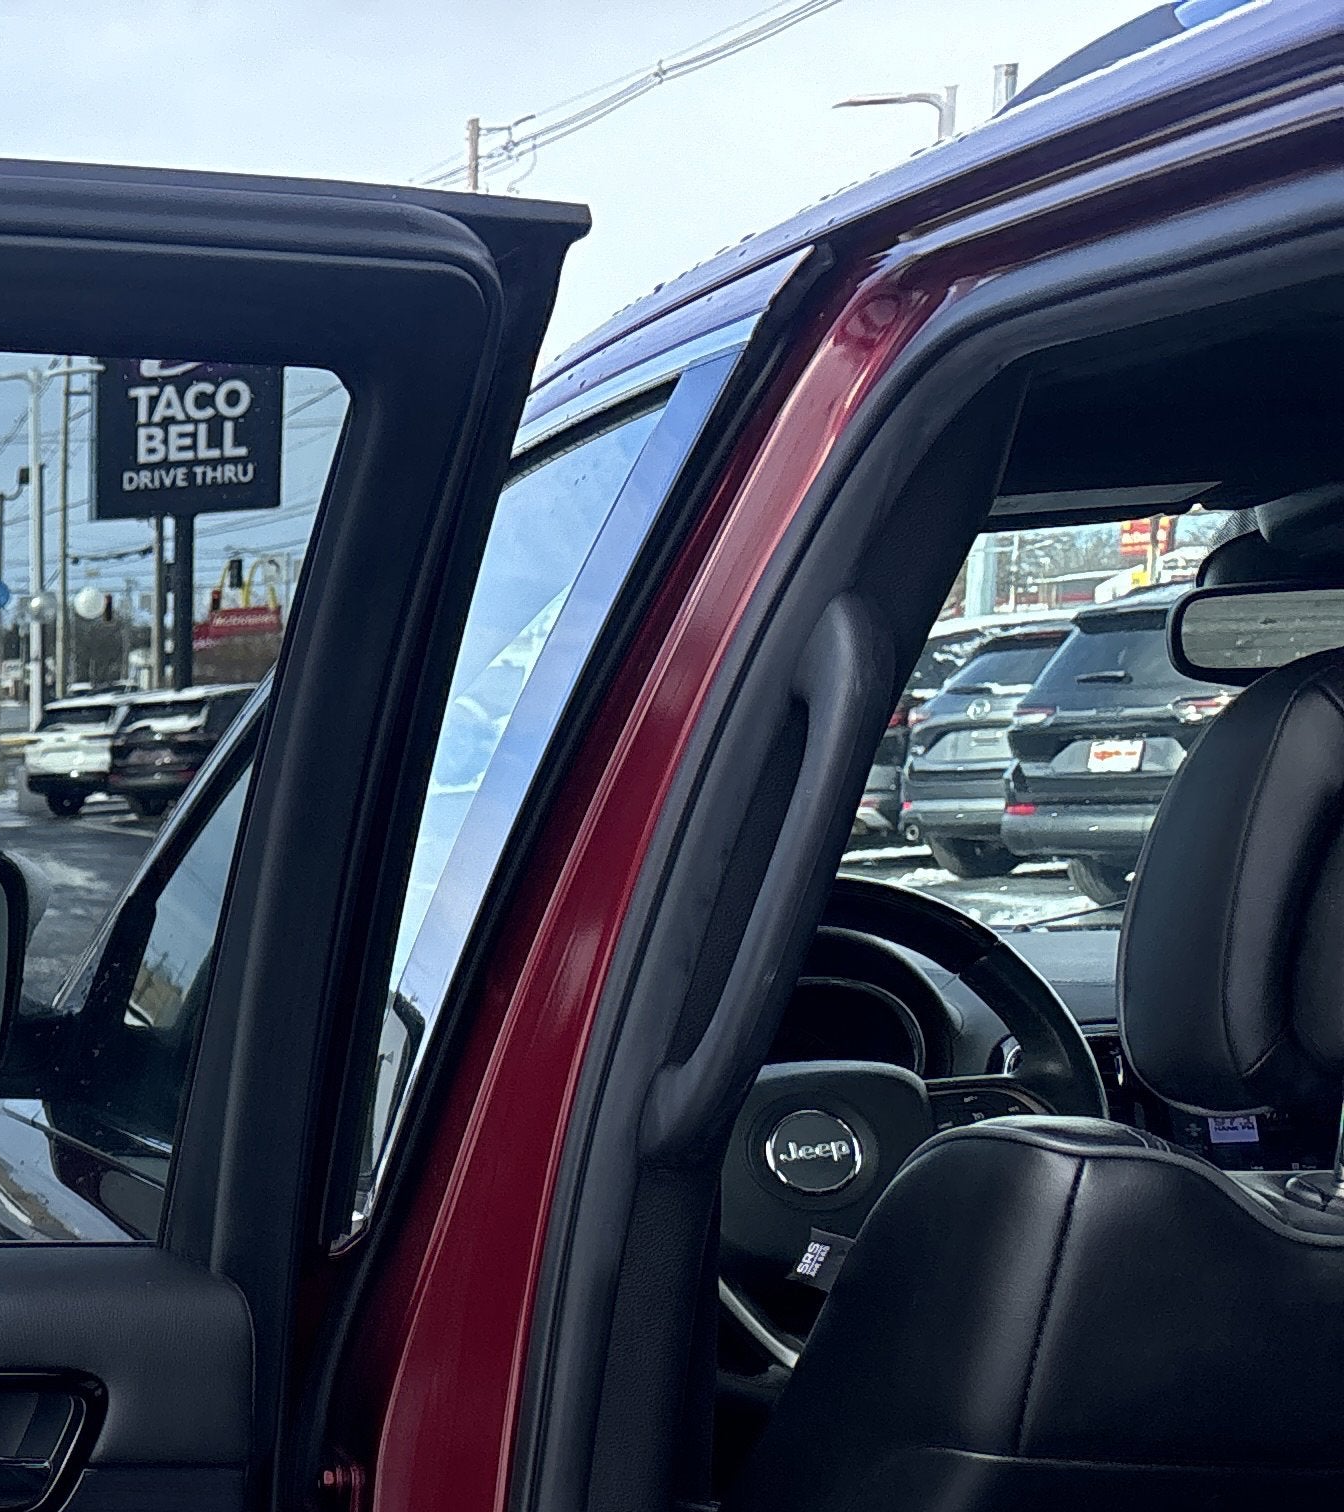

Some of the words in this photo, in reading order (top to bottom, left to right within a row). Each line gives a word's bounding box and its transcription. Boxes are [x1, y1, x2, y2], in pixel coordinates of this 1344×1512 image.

[127, 379, 252, 425] TACO
[136, 419, 249, 465] BELL
[122, 465, 189, 492] DRIVE
[192, 462, 254, 487] THRU
[779, 1140, 851, 1162] Jeep
[796, 1241, 821, 1275] SRS
